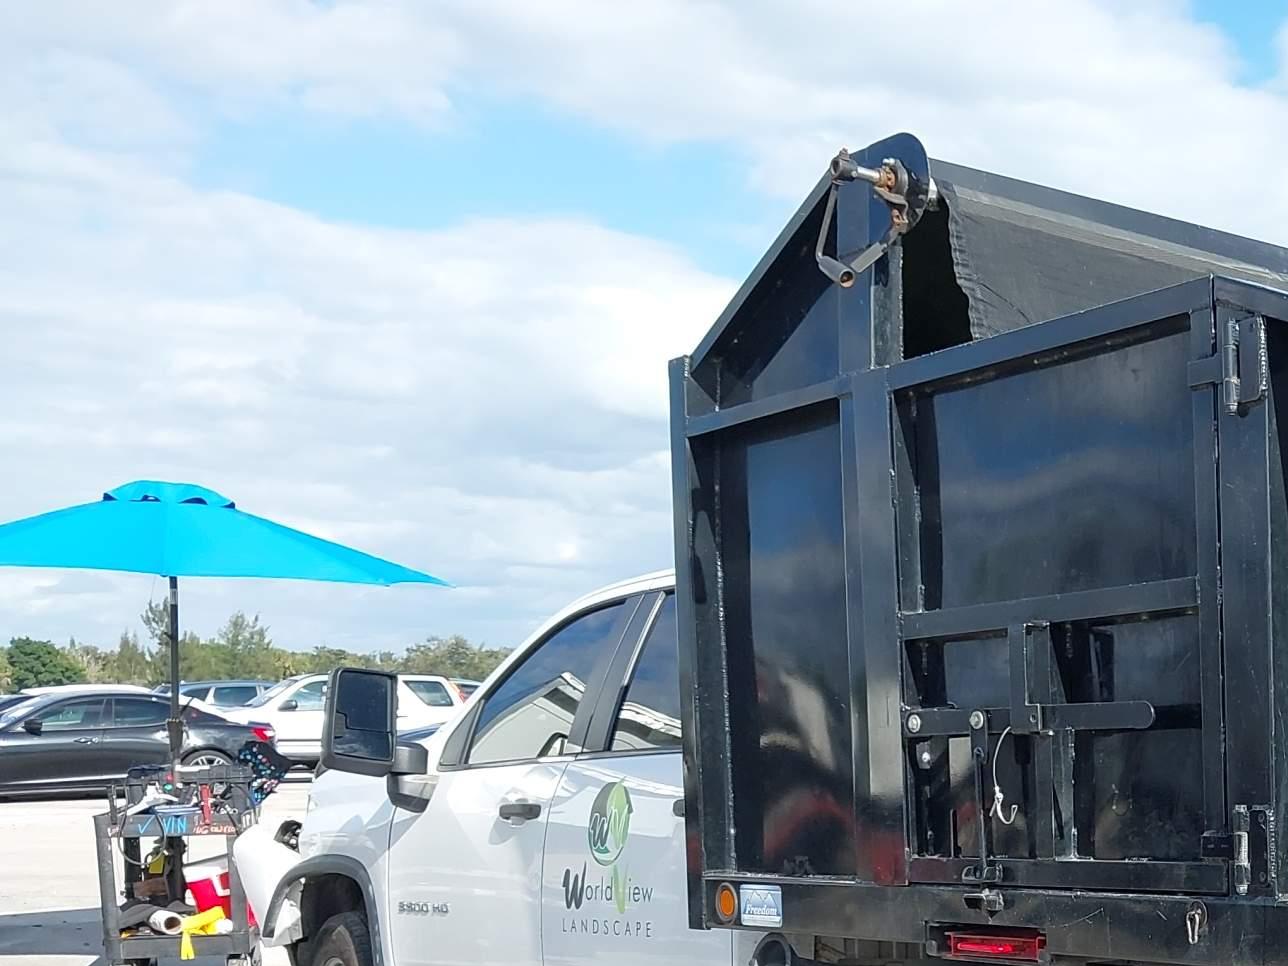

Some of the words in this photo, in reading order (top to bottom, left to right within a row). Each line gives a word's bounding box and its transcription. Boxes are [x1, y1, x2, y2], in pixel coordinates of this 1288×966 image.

[162, 817, 187, 834] VIN
[432, 903, 450, 914] HD
[745, 903, 778, 916] Freedom
[562, 919, 654, 938] LANDSCAPE
